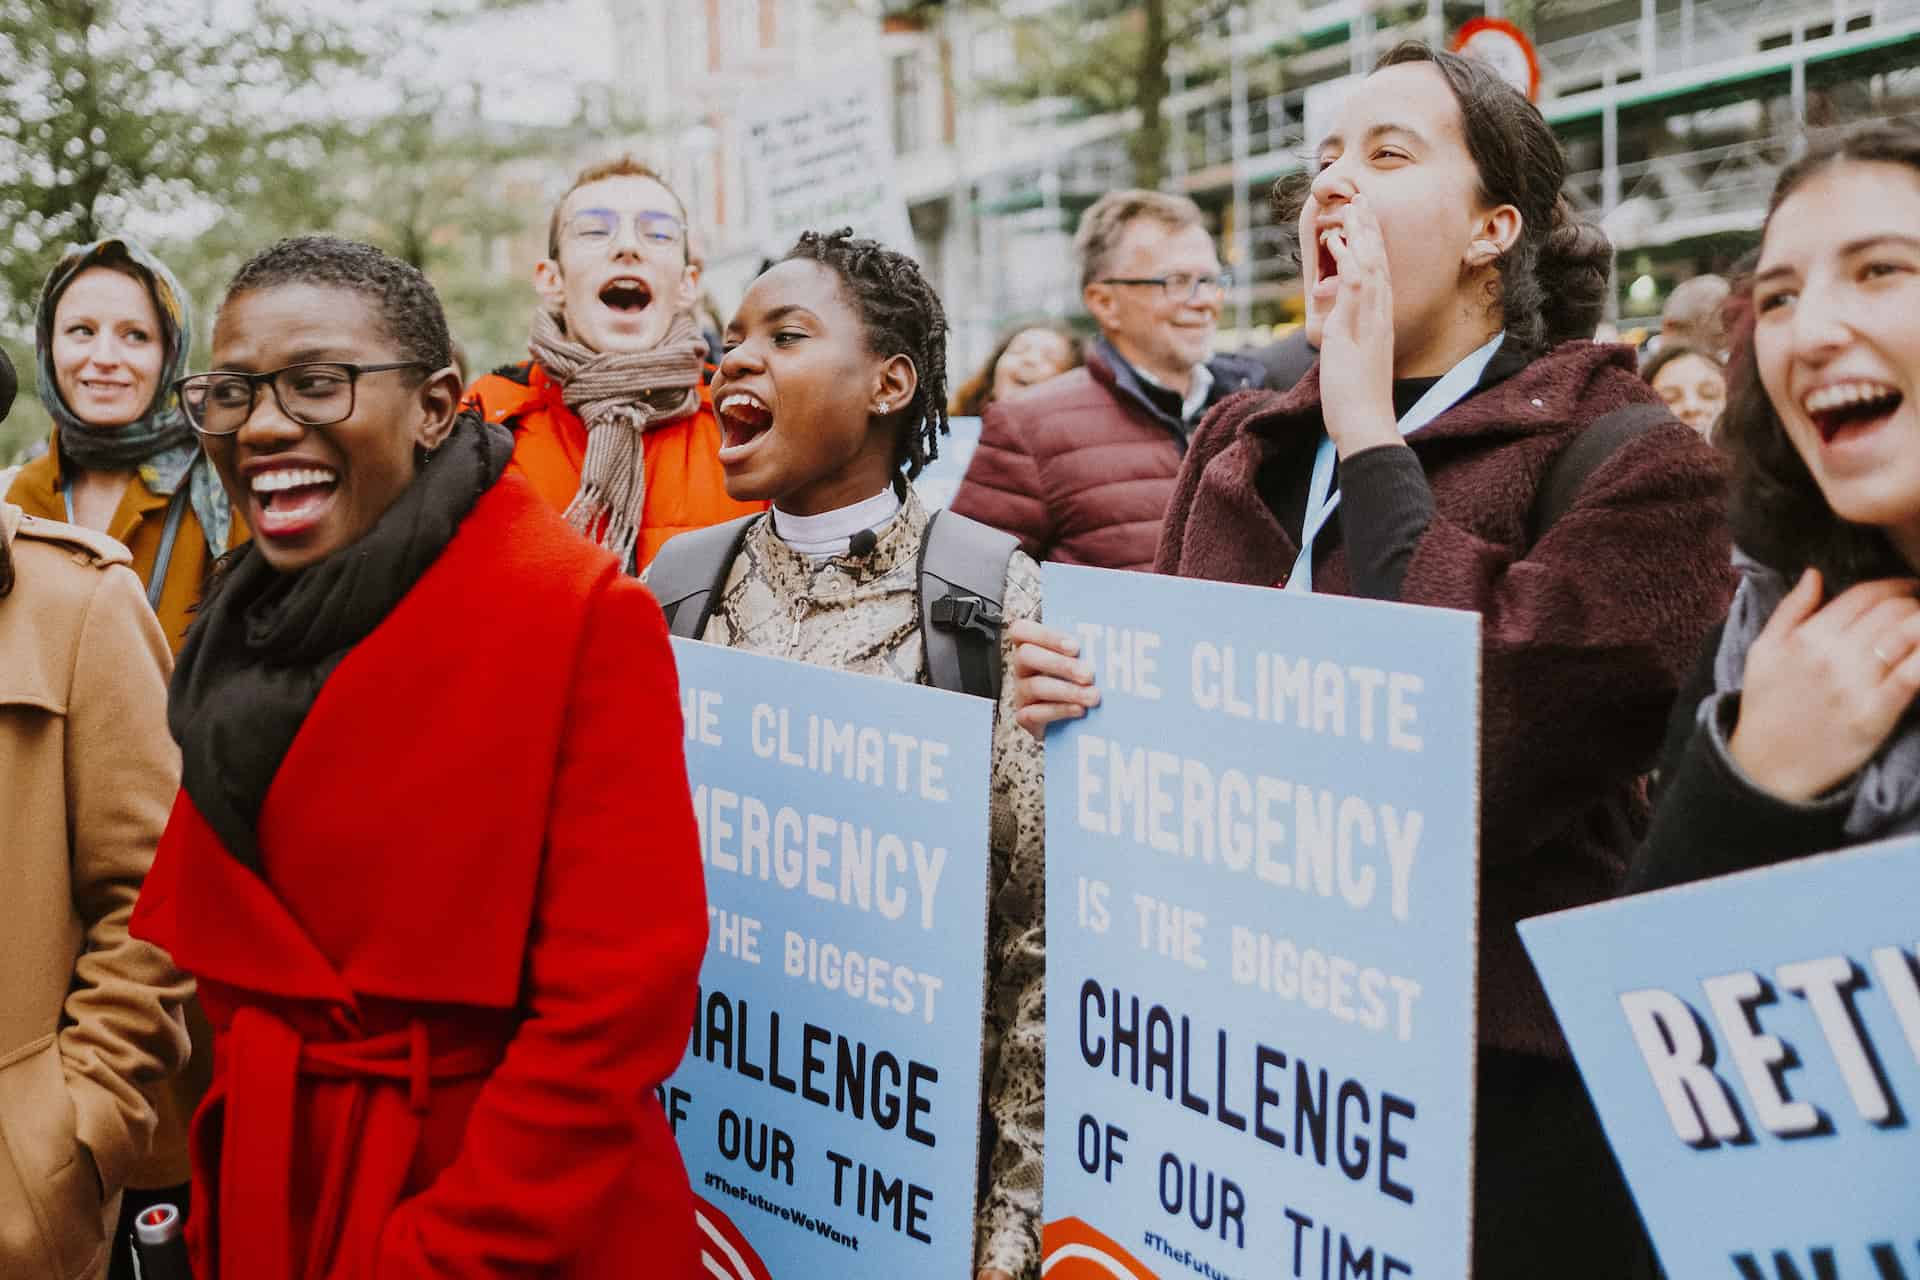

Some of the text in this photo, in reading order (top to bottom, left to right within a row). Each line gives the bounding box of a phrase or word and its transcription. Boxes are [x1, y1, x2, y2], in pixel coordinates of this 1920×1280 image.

[751, 703, 950, 801] CLIMATE
[1077, 623, 1425, 752] THE CLIMATE
[692, 784, 947, 931] ERGENCY
[1077, 734, 1424, 921] EMERGENCY
[708, 905, 944, 1024] HE BIGGEST
[1078, 876, 1423, 1041] IS THE BIGGEST
[692, 984, 938, 1147] ALLENGE
[1080, 978, 1416, 1206] CHALLENGE
[705, 1172, 858, 1251] #TheFutureWeWant
[718, 1108, 795, 1186] OUR
[826, 1150, 934, 1244] TIME
[1078, 1113, 1128, 1184] OF
[1159, 1152, 1245, 1249] OUR
